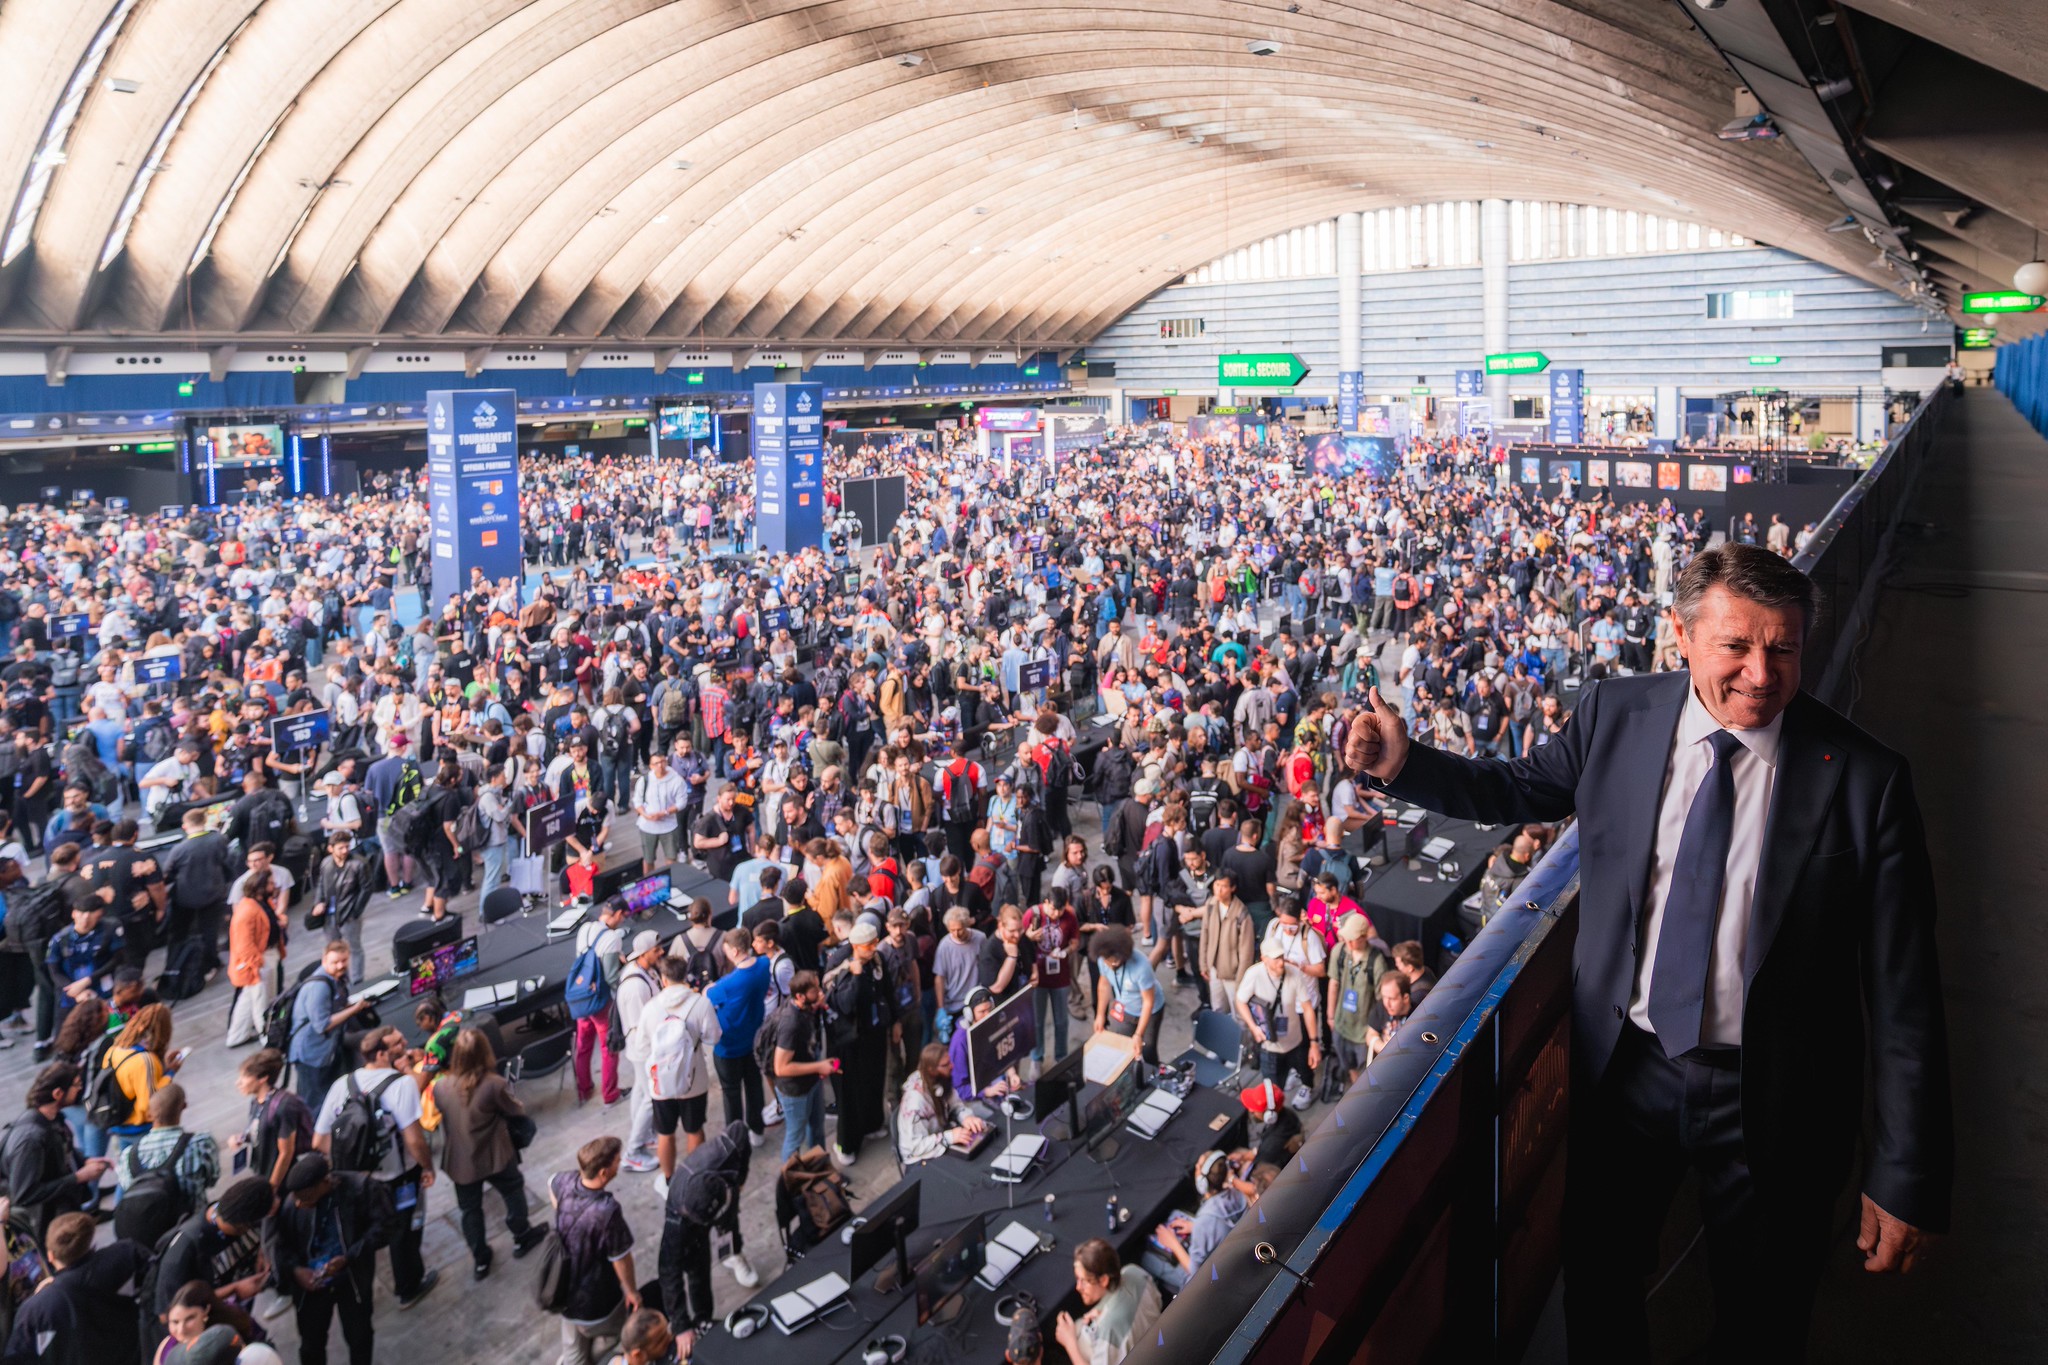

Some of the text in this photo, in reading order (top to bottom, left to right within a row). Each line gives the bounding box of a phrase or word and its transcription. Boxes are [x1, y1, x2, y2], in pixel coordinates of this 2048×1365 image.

[1223, 362, 1291, 377] SORTIE de SECOURS
[458, 431, 512, 446] TOURNAMENT
[475, 443, 497, 454] AREA
[996, 1031, 1015, 1060] 165
